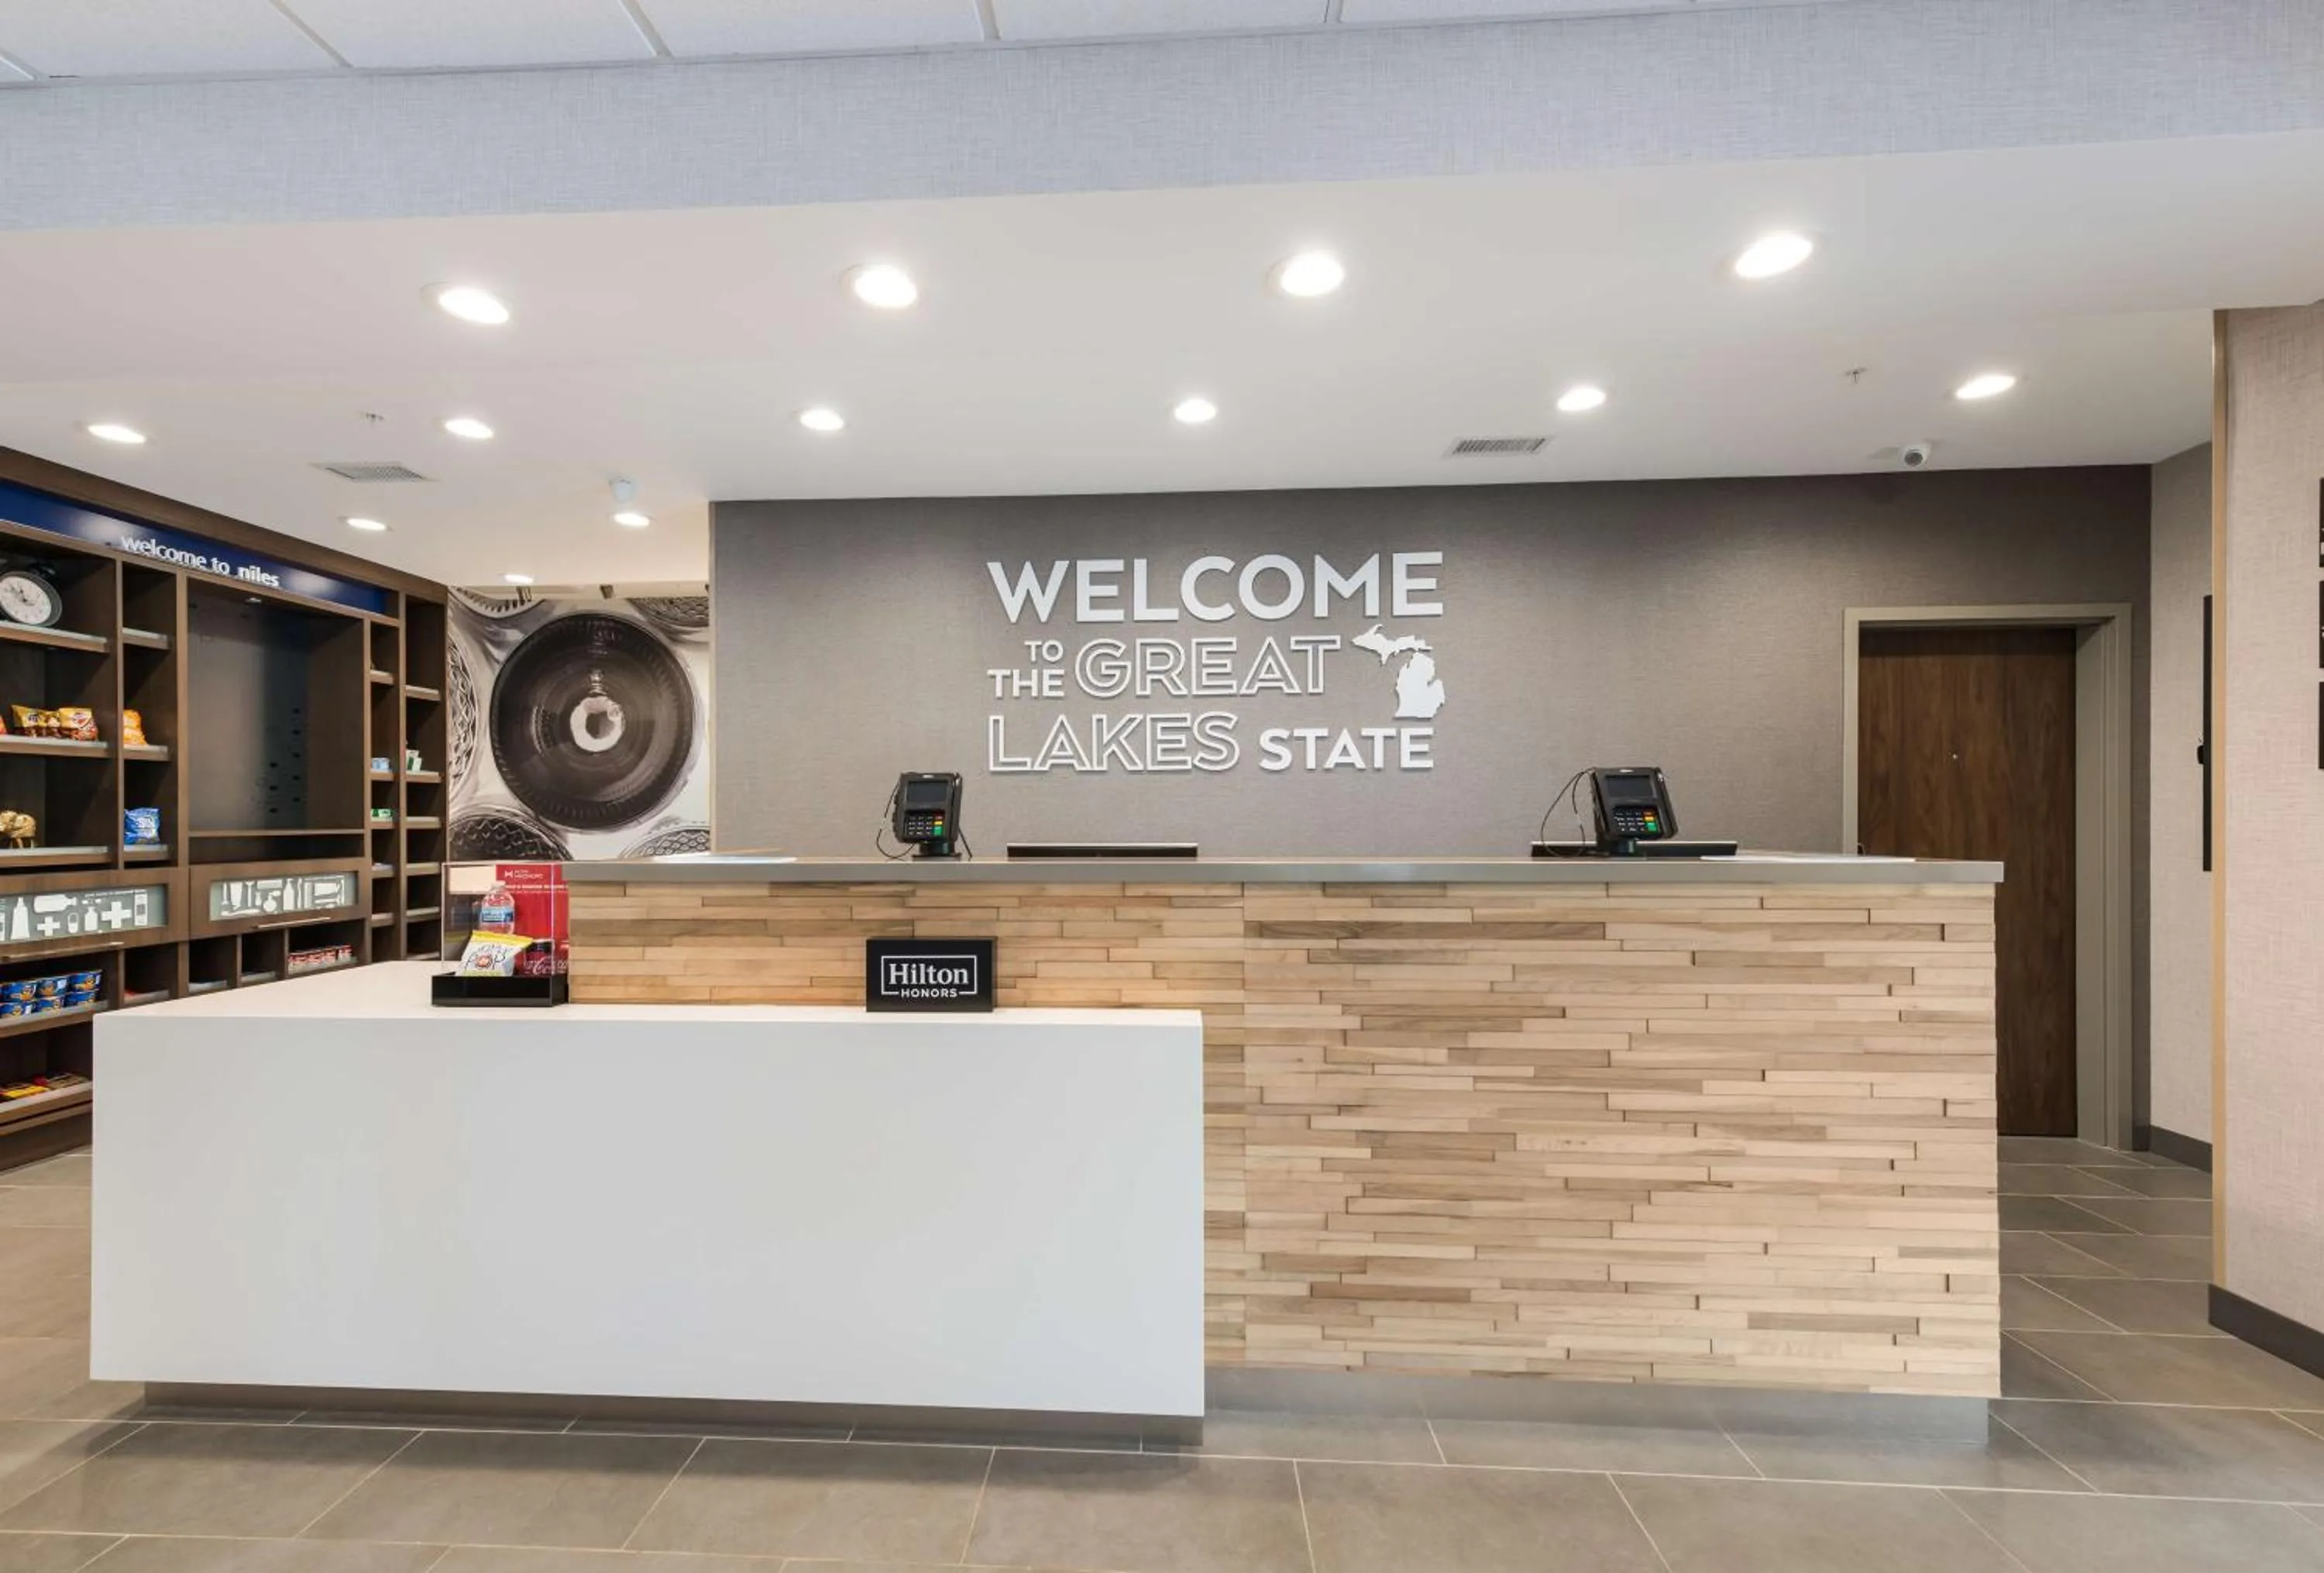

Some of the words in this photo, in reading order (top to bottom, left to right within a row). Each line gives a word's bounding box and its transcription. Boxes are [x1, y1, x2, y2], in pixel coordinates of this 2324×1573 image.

[122, 536, 206, 568] welcome
[211, 558, 230, 576] to
[236, 566, 279, 587] niles
[987, 552, 1443, 622] WELCOME
[1025, 640, 1064, 663] TO
[1075, 635, 1341, 698] GREAT
[988, 669, 1065, 698] THE
[989, 711, 1240, 772] LAKES
[1260, 728, 1435, 771] STATE
[889, 963, 969, 985] Hilton
[901, 988, 957, 998] HONORS
